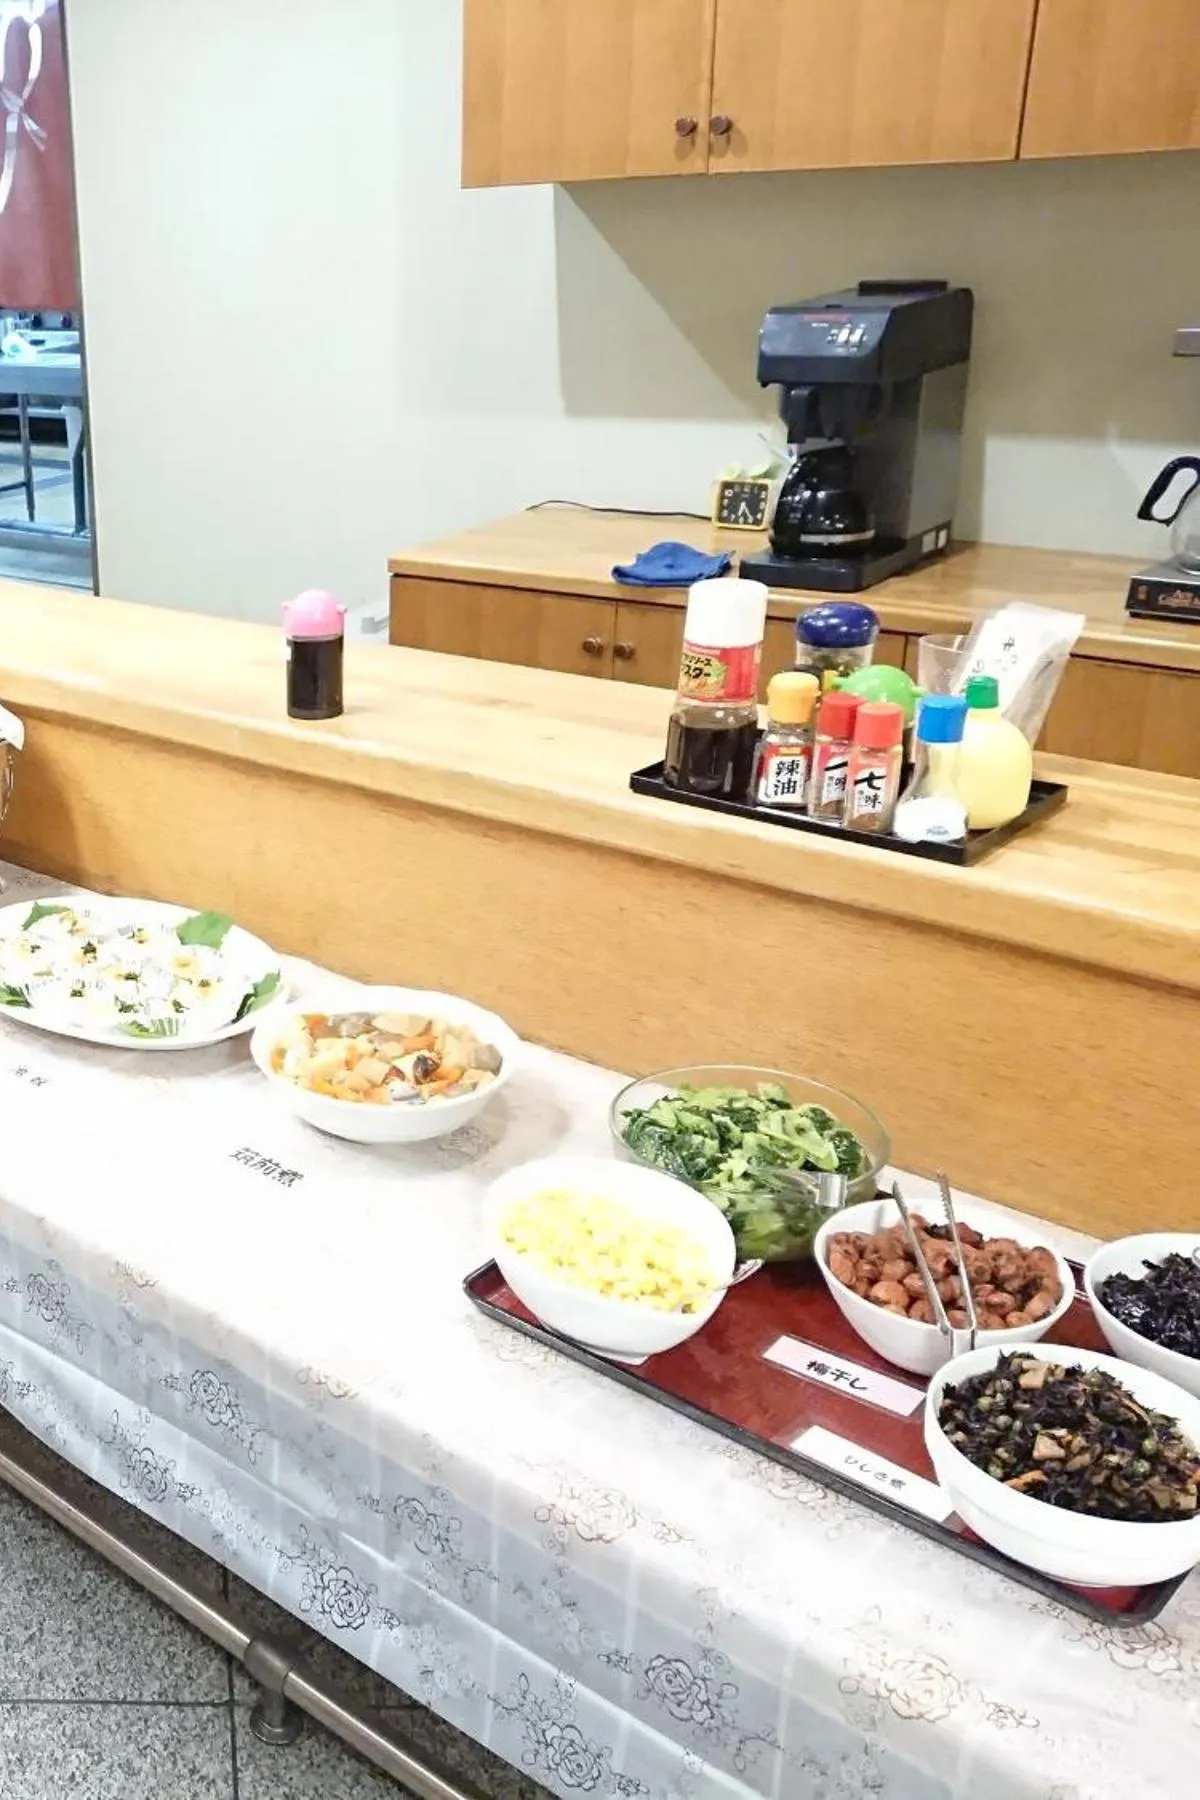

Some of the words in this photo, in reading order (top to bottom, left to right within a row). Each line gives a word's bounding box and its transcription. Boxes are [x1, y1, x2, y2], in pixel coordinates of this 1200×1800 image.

[774, 759, 800, 796] 辣油
[854, 771, 887, 808] 七味
[806, 1359, 869, 1391] 梅干し
